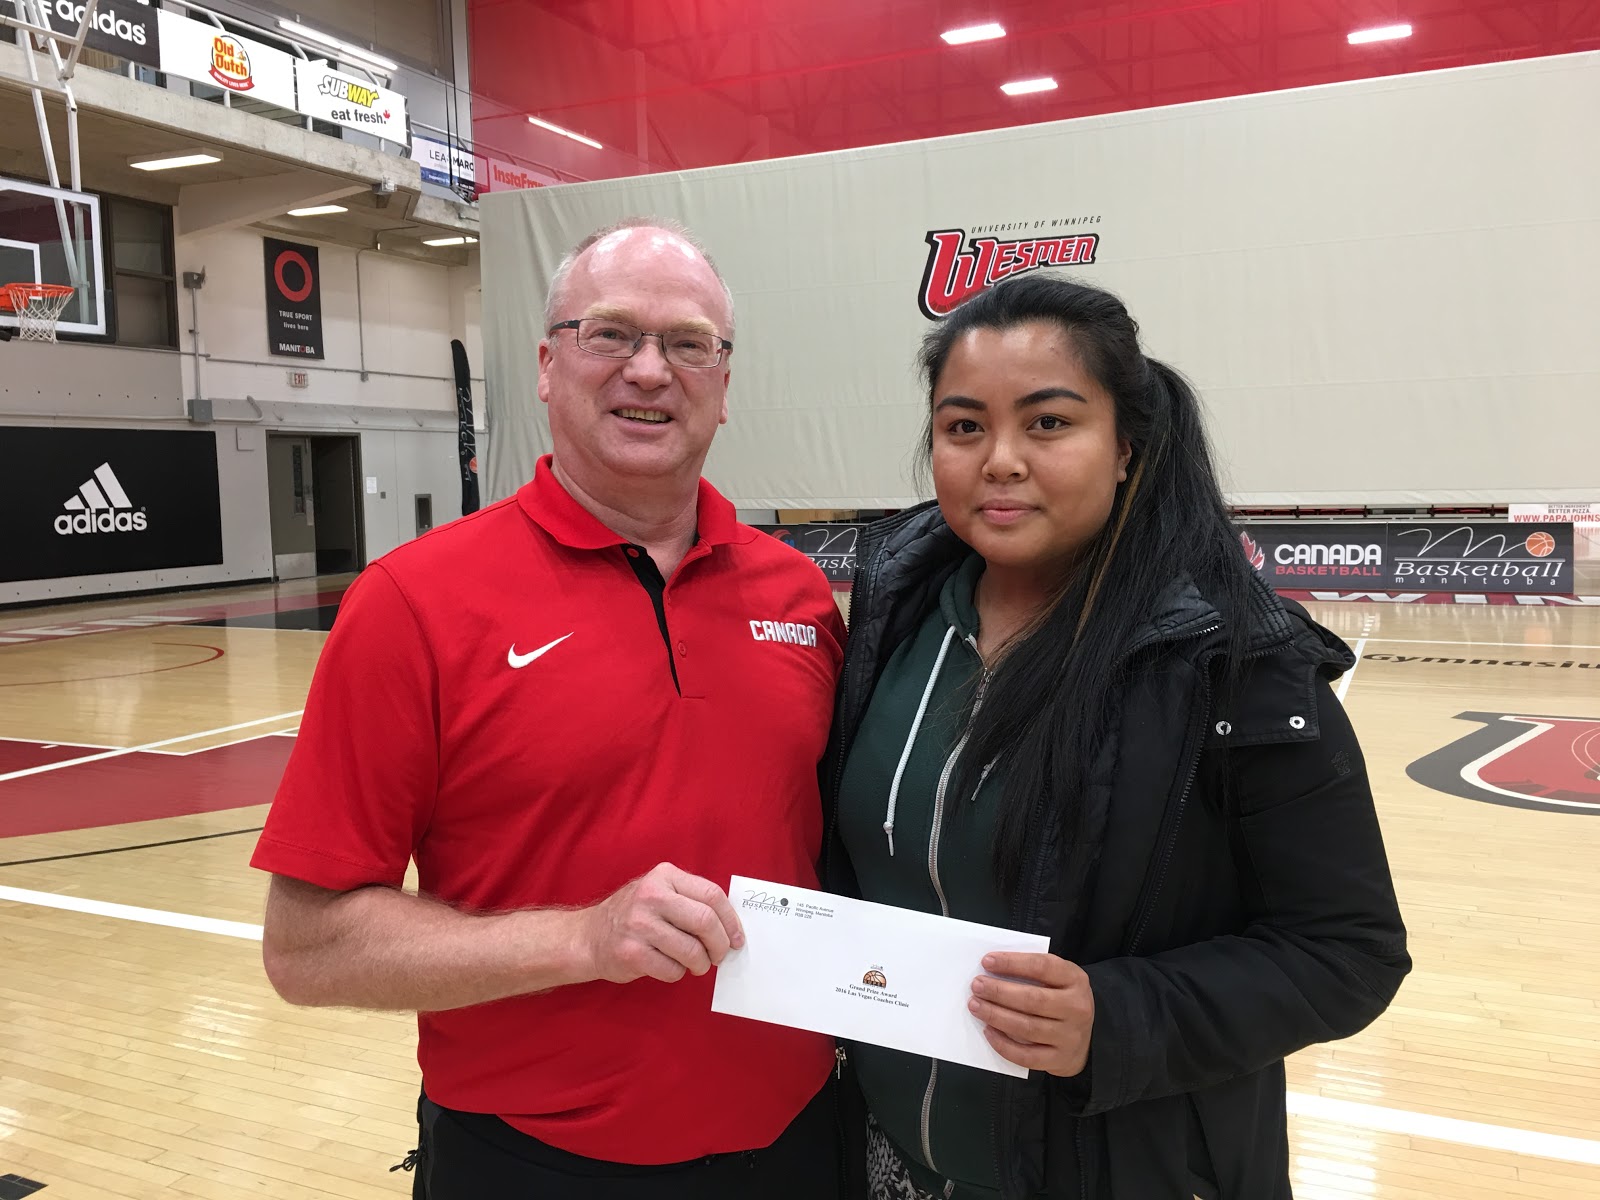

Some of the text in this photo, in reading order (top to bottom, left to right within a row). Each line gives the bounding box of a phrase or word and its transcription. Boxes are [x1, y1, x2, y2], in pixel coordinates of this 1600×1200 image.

[56, 0, 146, 45] adidas
[214, 36, 234, 57] Old
[215, 53, 247, 77] Dutch
[317, 75, 380, 108] SUBWAY
[331, 109, 351, 121] eat
[971, 215, 1102, 234] UNIVERSITY OF WINNIPEG
[279, 310, 312, 321] TRUE SPORT
[283, 321, 309, 331] lives here
[279, 342, 315, 354] MANITOBA
[54, 507, 147, 535] adidas
[1274, 544, 1382, 565] CANADA
[1275, 565, 1381, 576] BASKETBALL
[1393, 561, 1563, 578] Basketball
[749, 620, 817, 647] CANADA
[742, 900, 790, 914] Basketball
[835, 986, 847, 994] 2016
[857, 991, 873, 1000] Vegas
[873, 995, 894, 1005] Coaches
[894, 1000, 910, 1008] Clinic
[849, 983, 866, 992] Grand
[866, 987, 880, 995] Prize
[879, 991, 898, 999] Award
